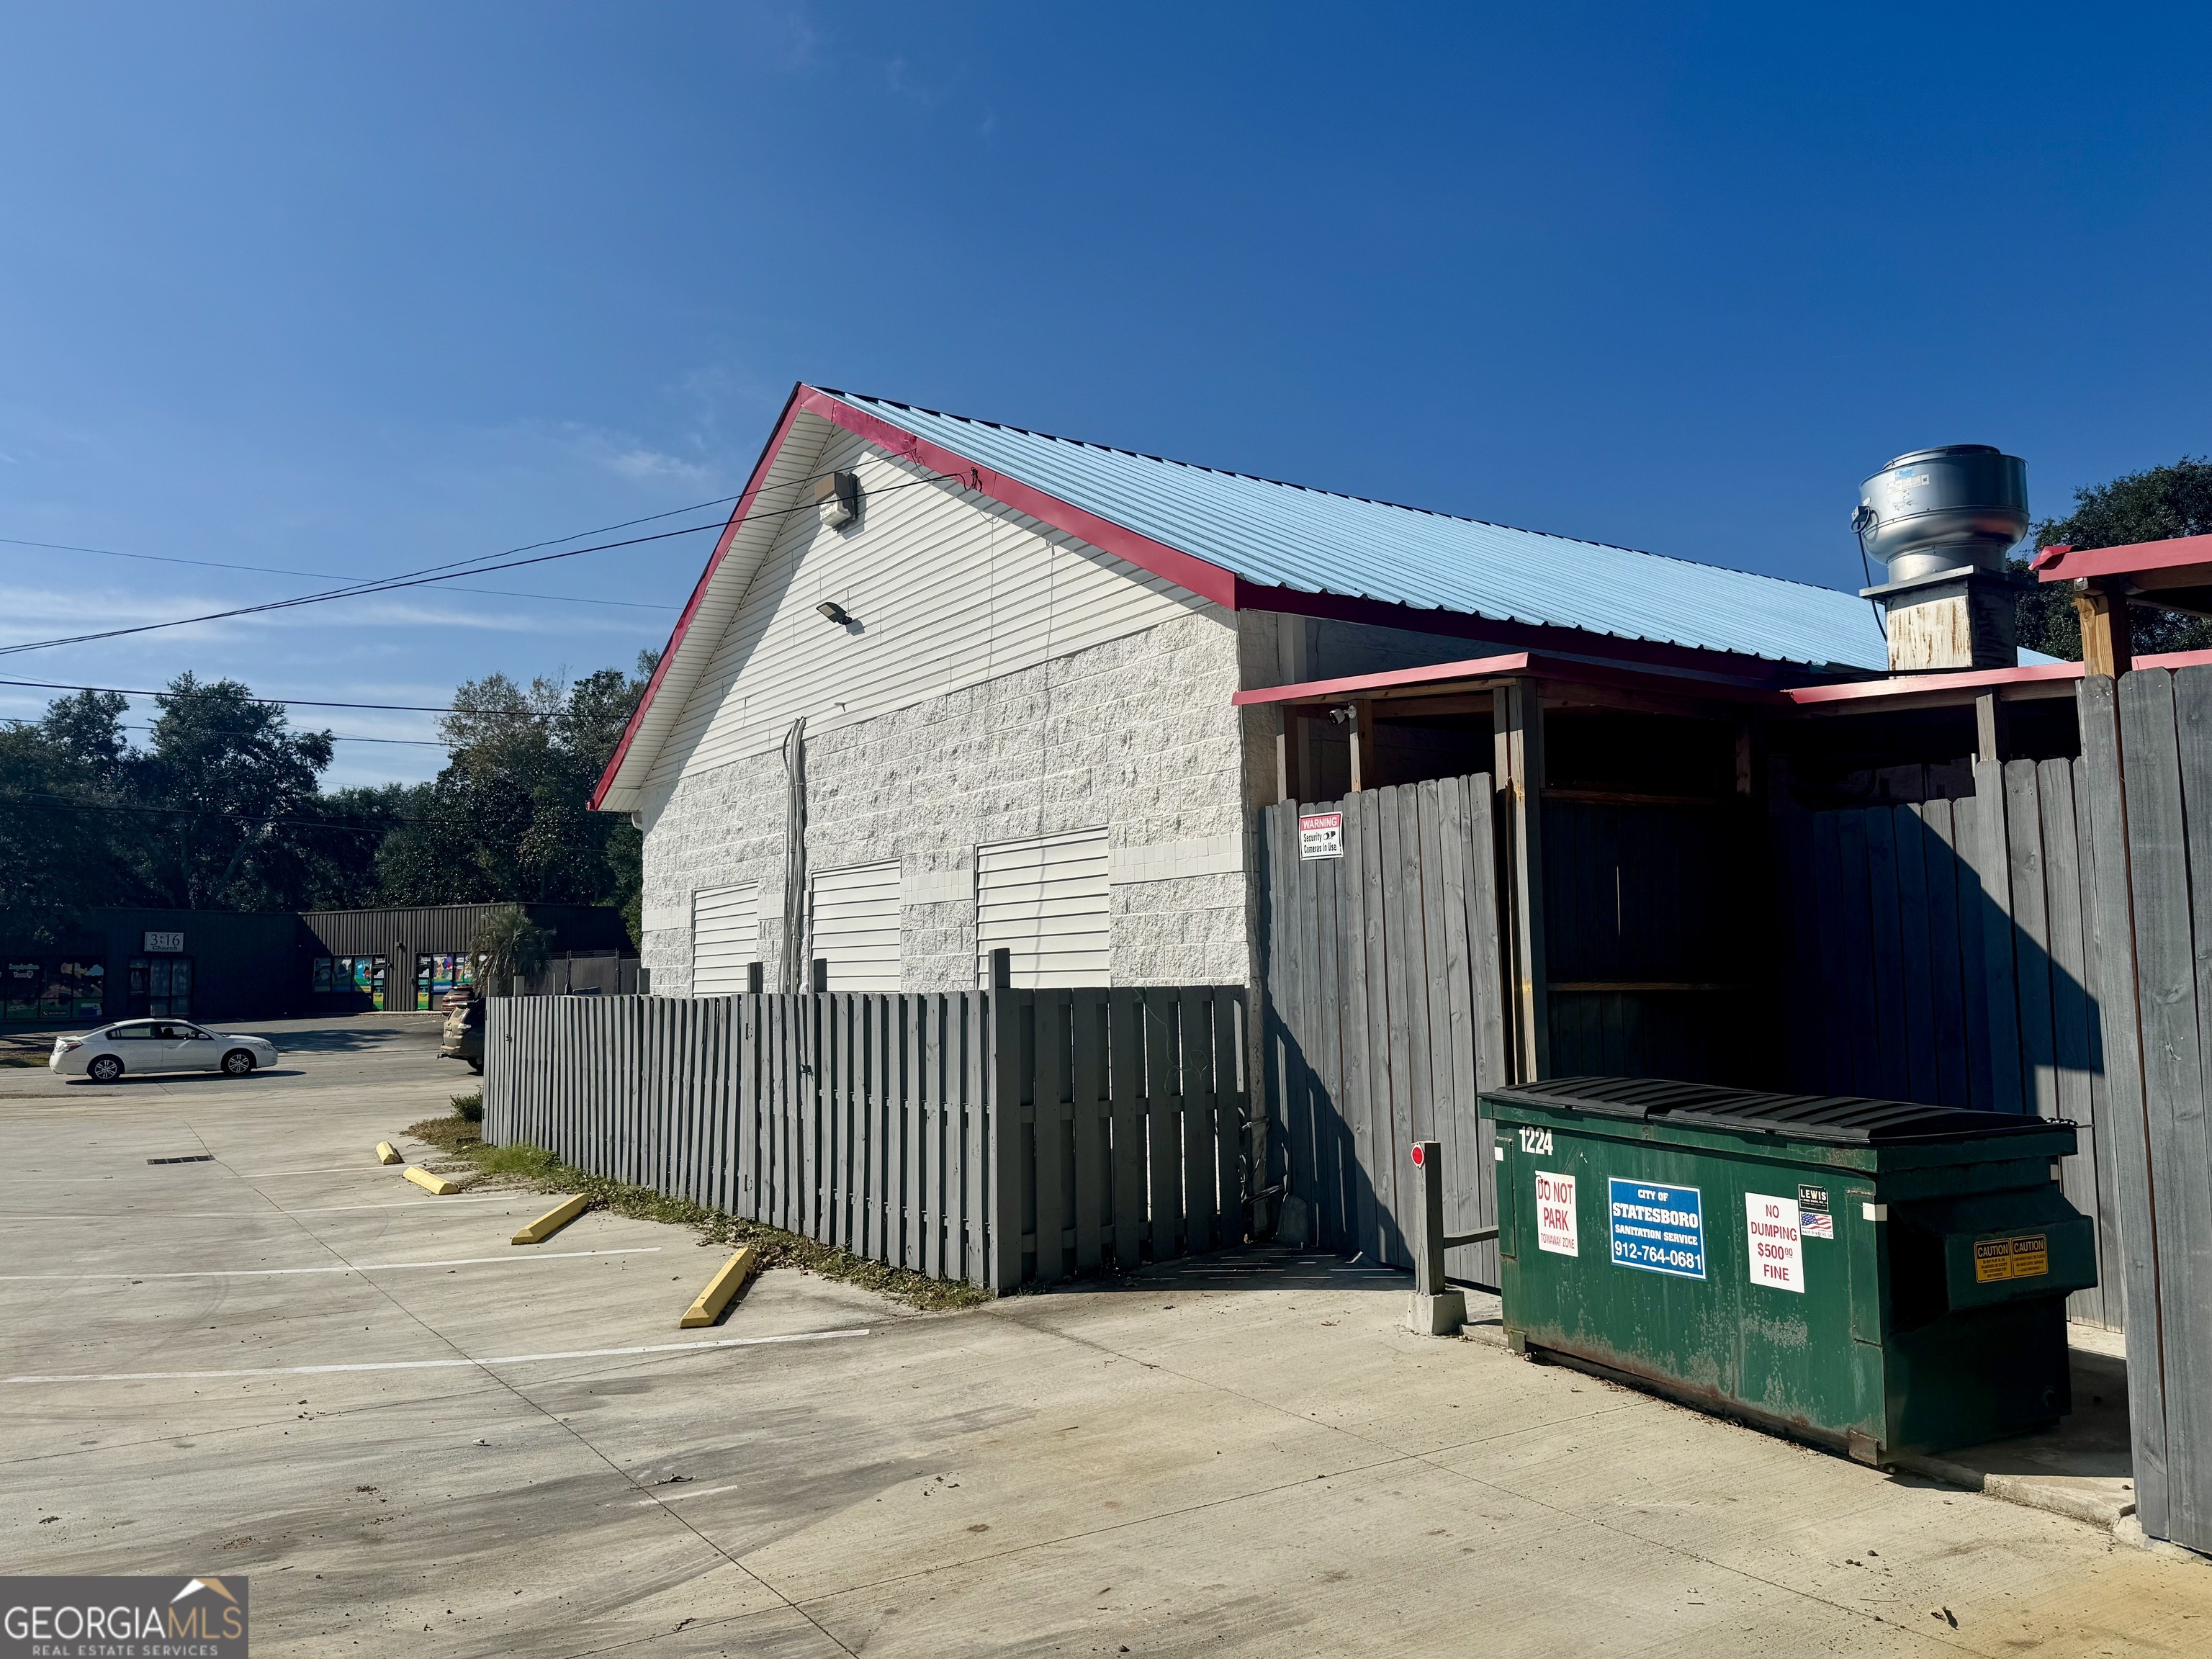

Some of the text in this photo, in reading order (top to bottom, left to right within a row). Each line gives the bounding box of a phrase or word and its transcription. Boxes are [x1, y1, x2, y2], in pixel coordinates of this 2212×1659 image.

[1303, 817, 1337, 830] WARNING
[1303, 832, 1322, 842] Security
[1304, 844, 1322, 853] Cameras
[1328, 842, 1337, 851] Use
[150, 934, 180, 946] 3:16
[1519, 1126, 1554, 1156] 1224
[1537, 1179, 1573, 1205] DO NOT
[1637, 1189, 1669, 1202] CITY OF
[1800, 1188, 1827, 1201] LEWIS
[1612, 1202, 1699, 1228] STATESBORO
[1765, 1204, 1780, 1218] NO
[1543, 1207, 1569, 1231] PARK
[1614, 1223, 1698, 1246] SANITATION SERVICE
[1750, 1221, 1798, 1242] DUMPING
[1540, 1233, 1575, 1249] TOWAWAY ZONE
[2013, 1239, 2044, 1253] CAUTION
[1614, 1240, 1702, 1270] 912-764-0681
[1977, 1244, 2009, 1257] CAUTION
[1763, 1264, 1790, 1282] FINE
